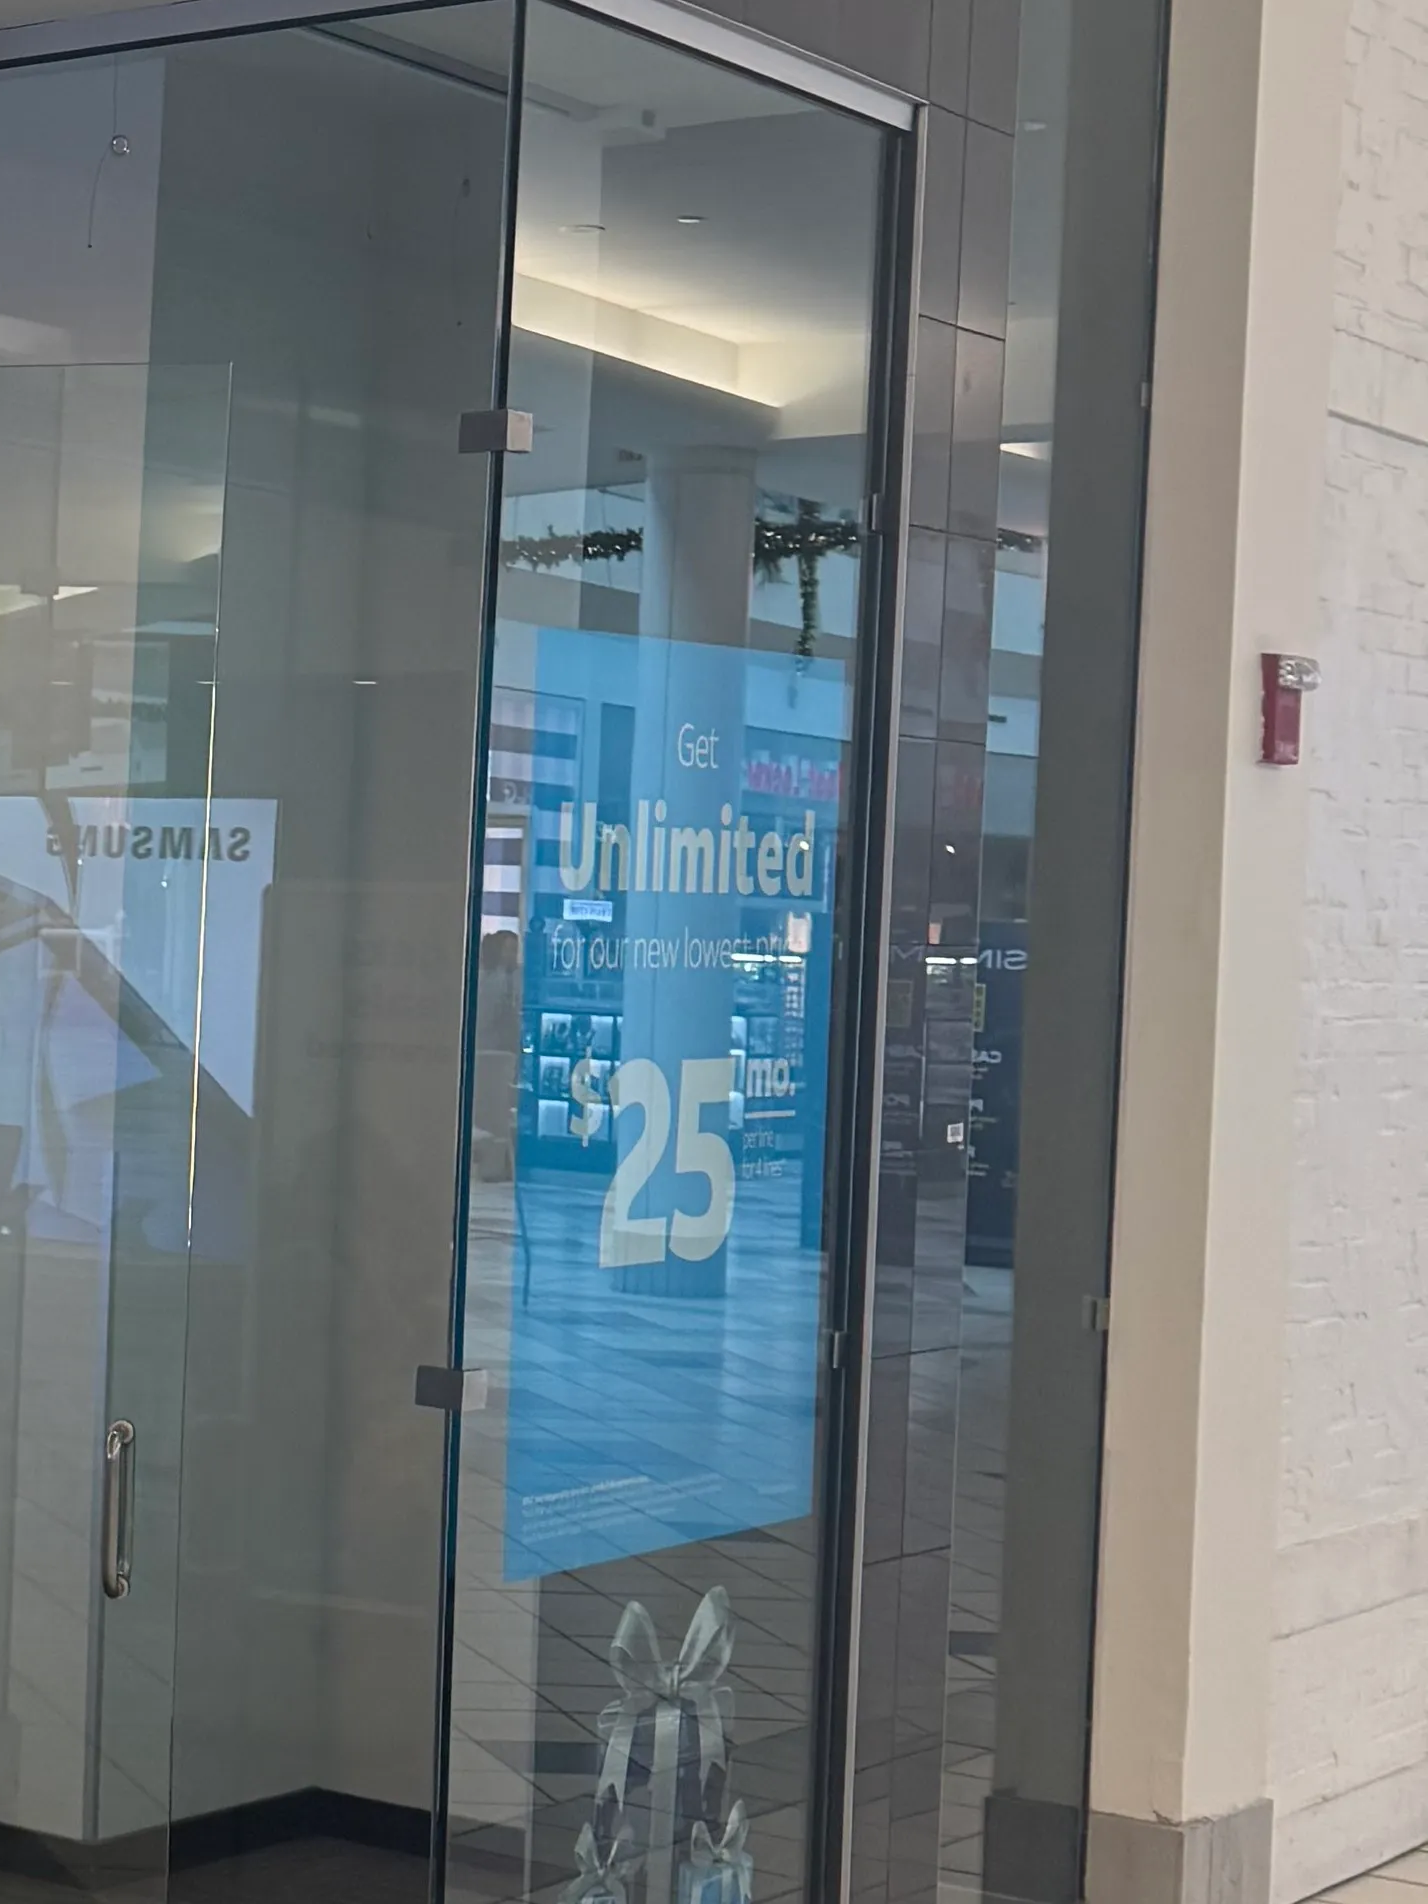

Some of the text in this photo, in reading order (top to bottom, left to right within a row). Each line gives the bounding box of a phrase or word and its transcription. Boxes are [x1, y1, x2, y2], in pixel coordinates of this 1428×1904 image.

[677, 722, 720, 769] Get
[558, 799, 816, 897] Unlimited
[551, 924, 586, 970] for
[590, 935, 629, 970] our
[633, 936, 679, 969] new
[569, 1046, 796, 1269] $25 mo.
